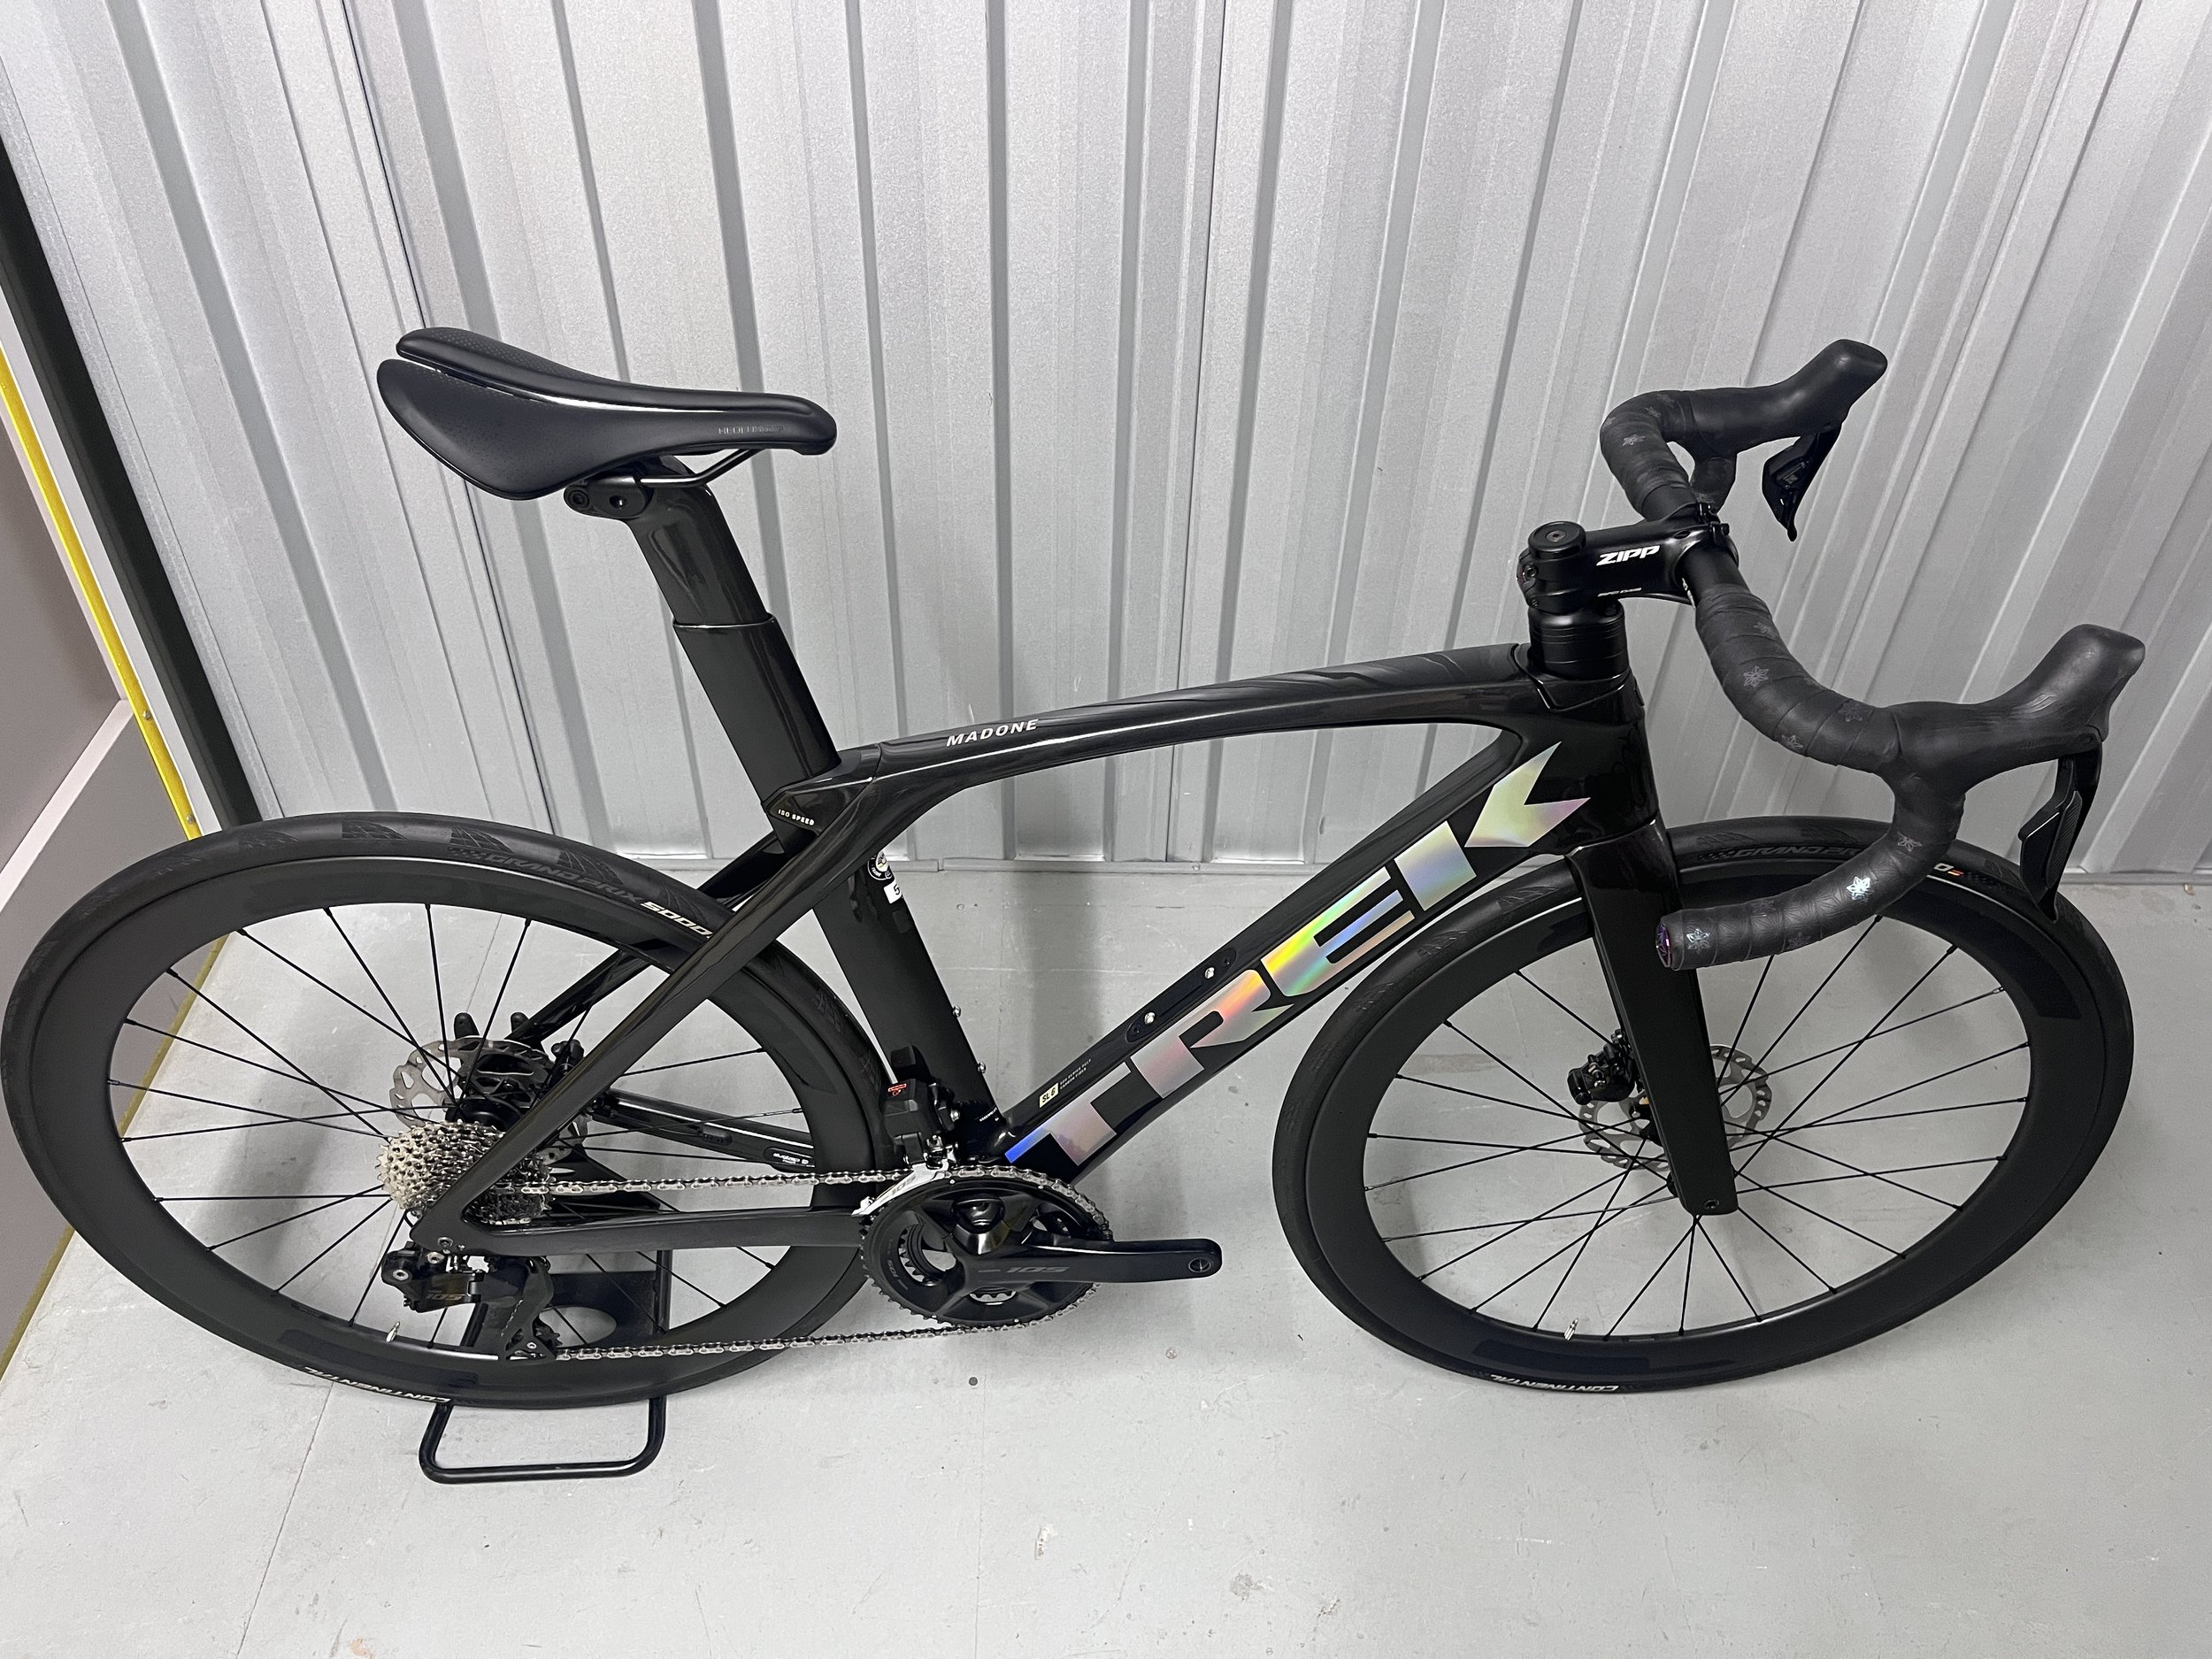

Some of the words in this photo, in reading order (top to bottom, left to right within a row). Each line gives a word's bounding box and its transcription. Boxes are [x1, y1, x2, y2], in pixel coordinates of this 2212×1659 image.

[1596, 545, 1661, 566] ZIPP
[946, 718, 1040, 747] MADONE
[778, 809, 790, 818] ISO
[791, 813, 815, 826] SPEED
[487, 854, 580, 880] GRAND
[577, 877, 645, 902] PRIX
[640, 901, 714, 936] 5000
[1004, 741, 1591, 1167] TREK
